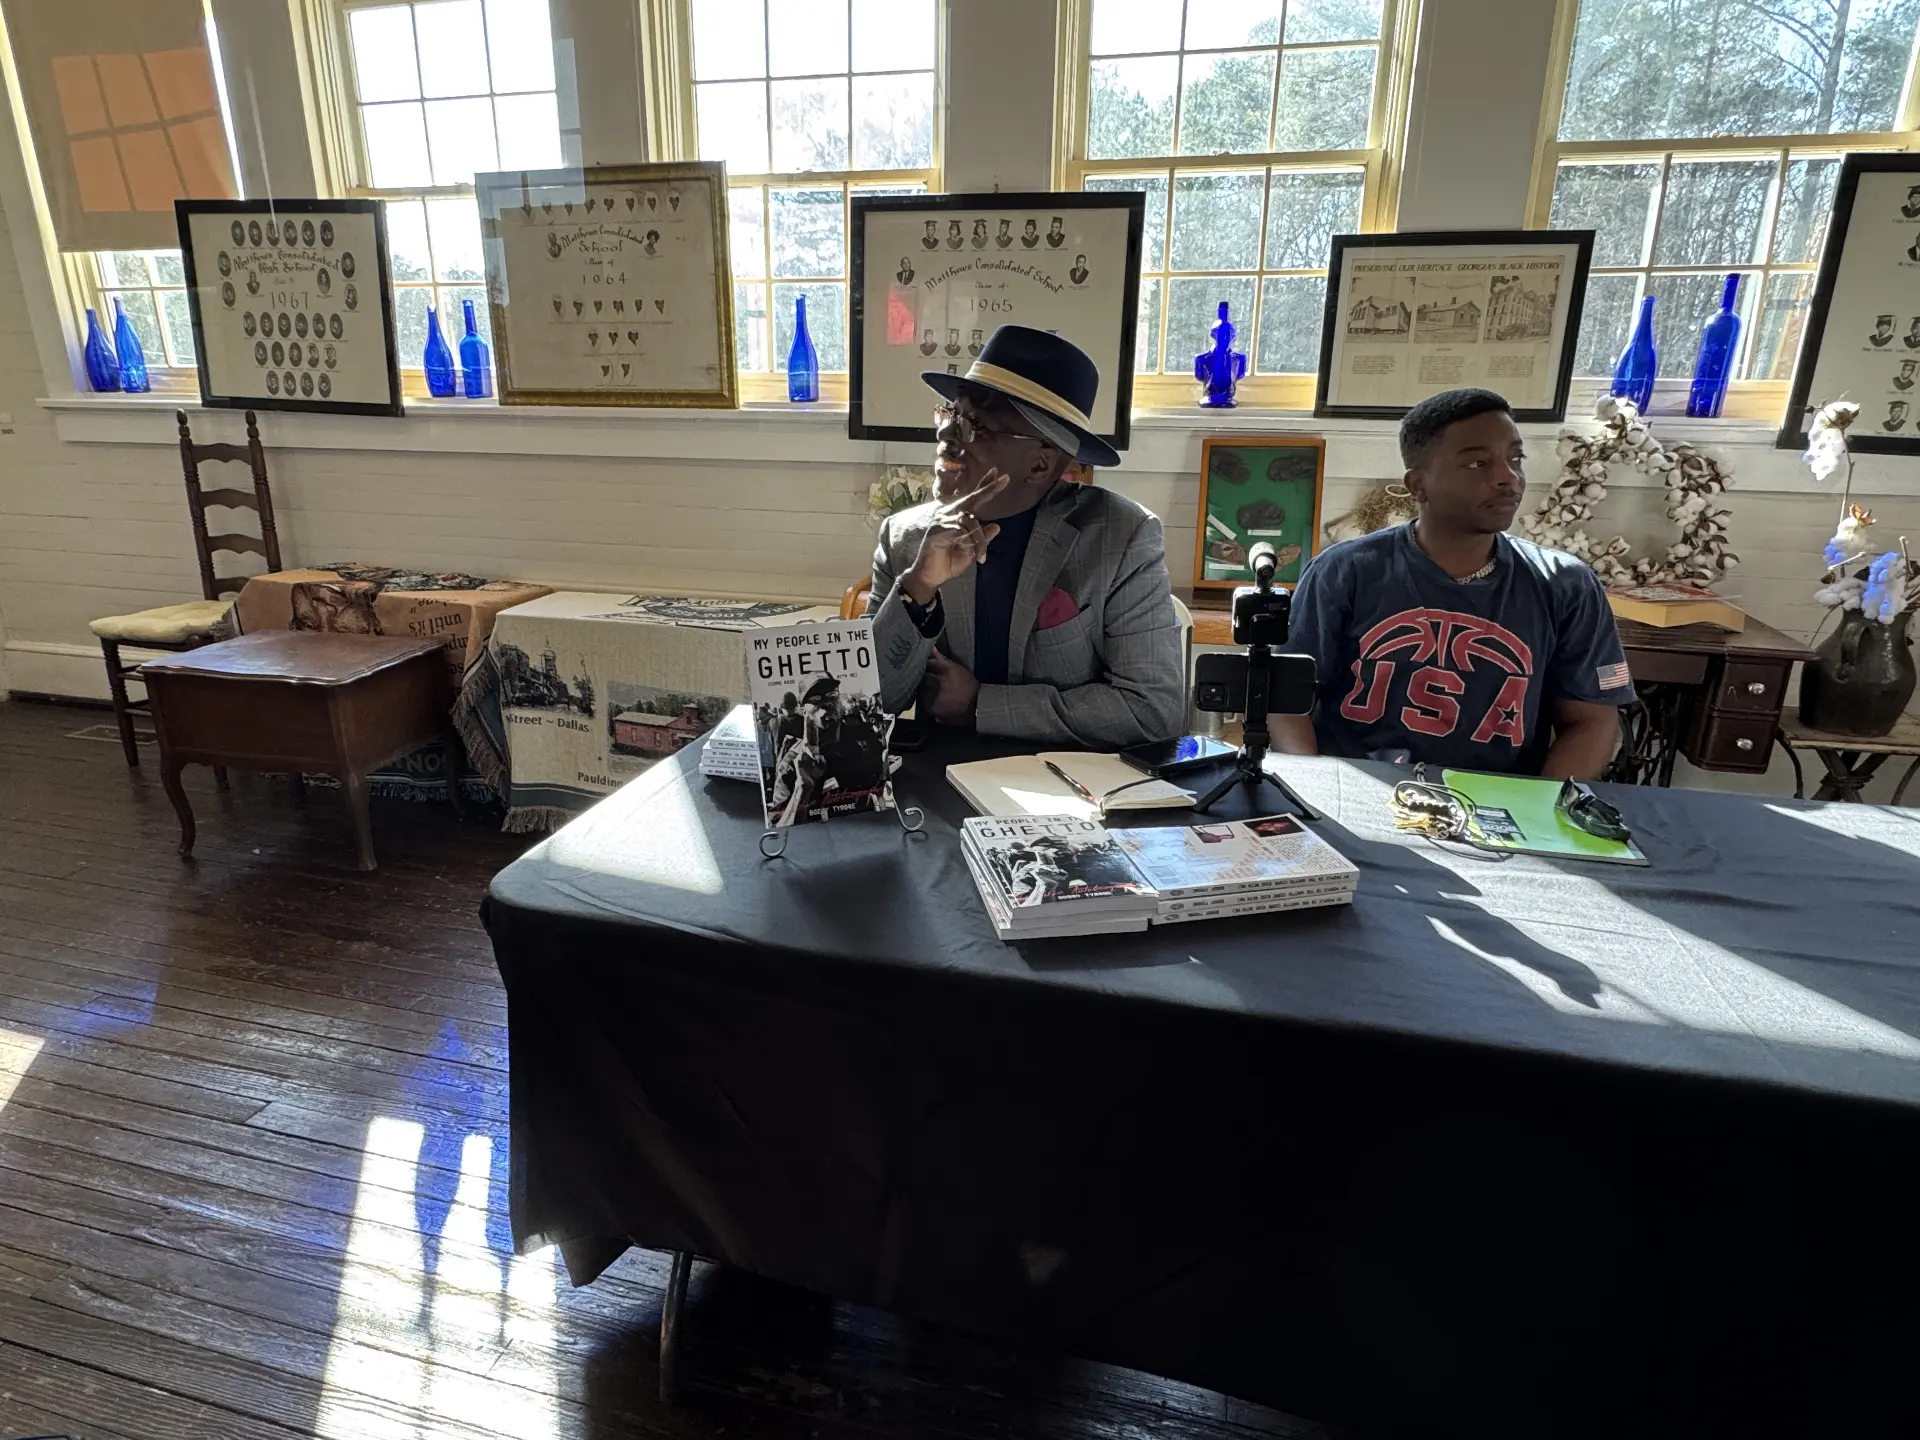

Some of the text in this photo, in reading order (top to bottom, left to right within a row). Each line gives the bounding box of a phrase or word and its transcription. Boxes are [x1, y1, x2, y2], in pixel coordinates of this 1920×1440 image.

[579, 240, 623, 253] School
[923, 257, 1064, 294] Matthews Consolidated School
[1354, 264, 1397, 273] PRESERVING
[1398, 264, 1416, 272] OUR
[1416, 263, 1453, 272] HERITAGE
[1498, 263, 1525, 271] BLACK
[1526, 262, 1561, 270] HISTORY
[270, 291, 309, 309] 1967
[970, 298, 1013, 312] 1965
[429, 613, 463, 635] until
[754, 629, 869, 651] MY PEOPLE IN THE
[757, 646, 871, 680] GHETTO
[1340, 659, 1529, 747] USA
[509, 713, 543, 725] Street
[557, 718, 590, 733] Dallas
[973, 819, 989, 827] MY
[995, 817, 1038, 826] PEOPLE
[980, 821, 1097, 839] GHETTO
